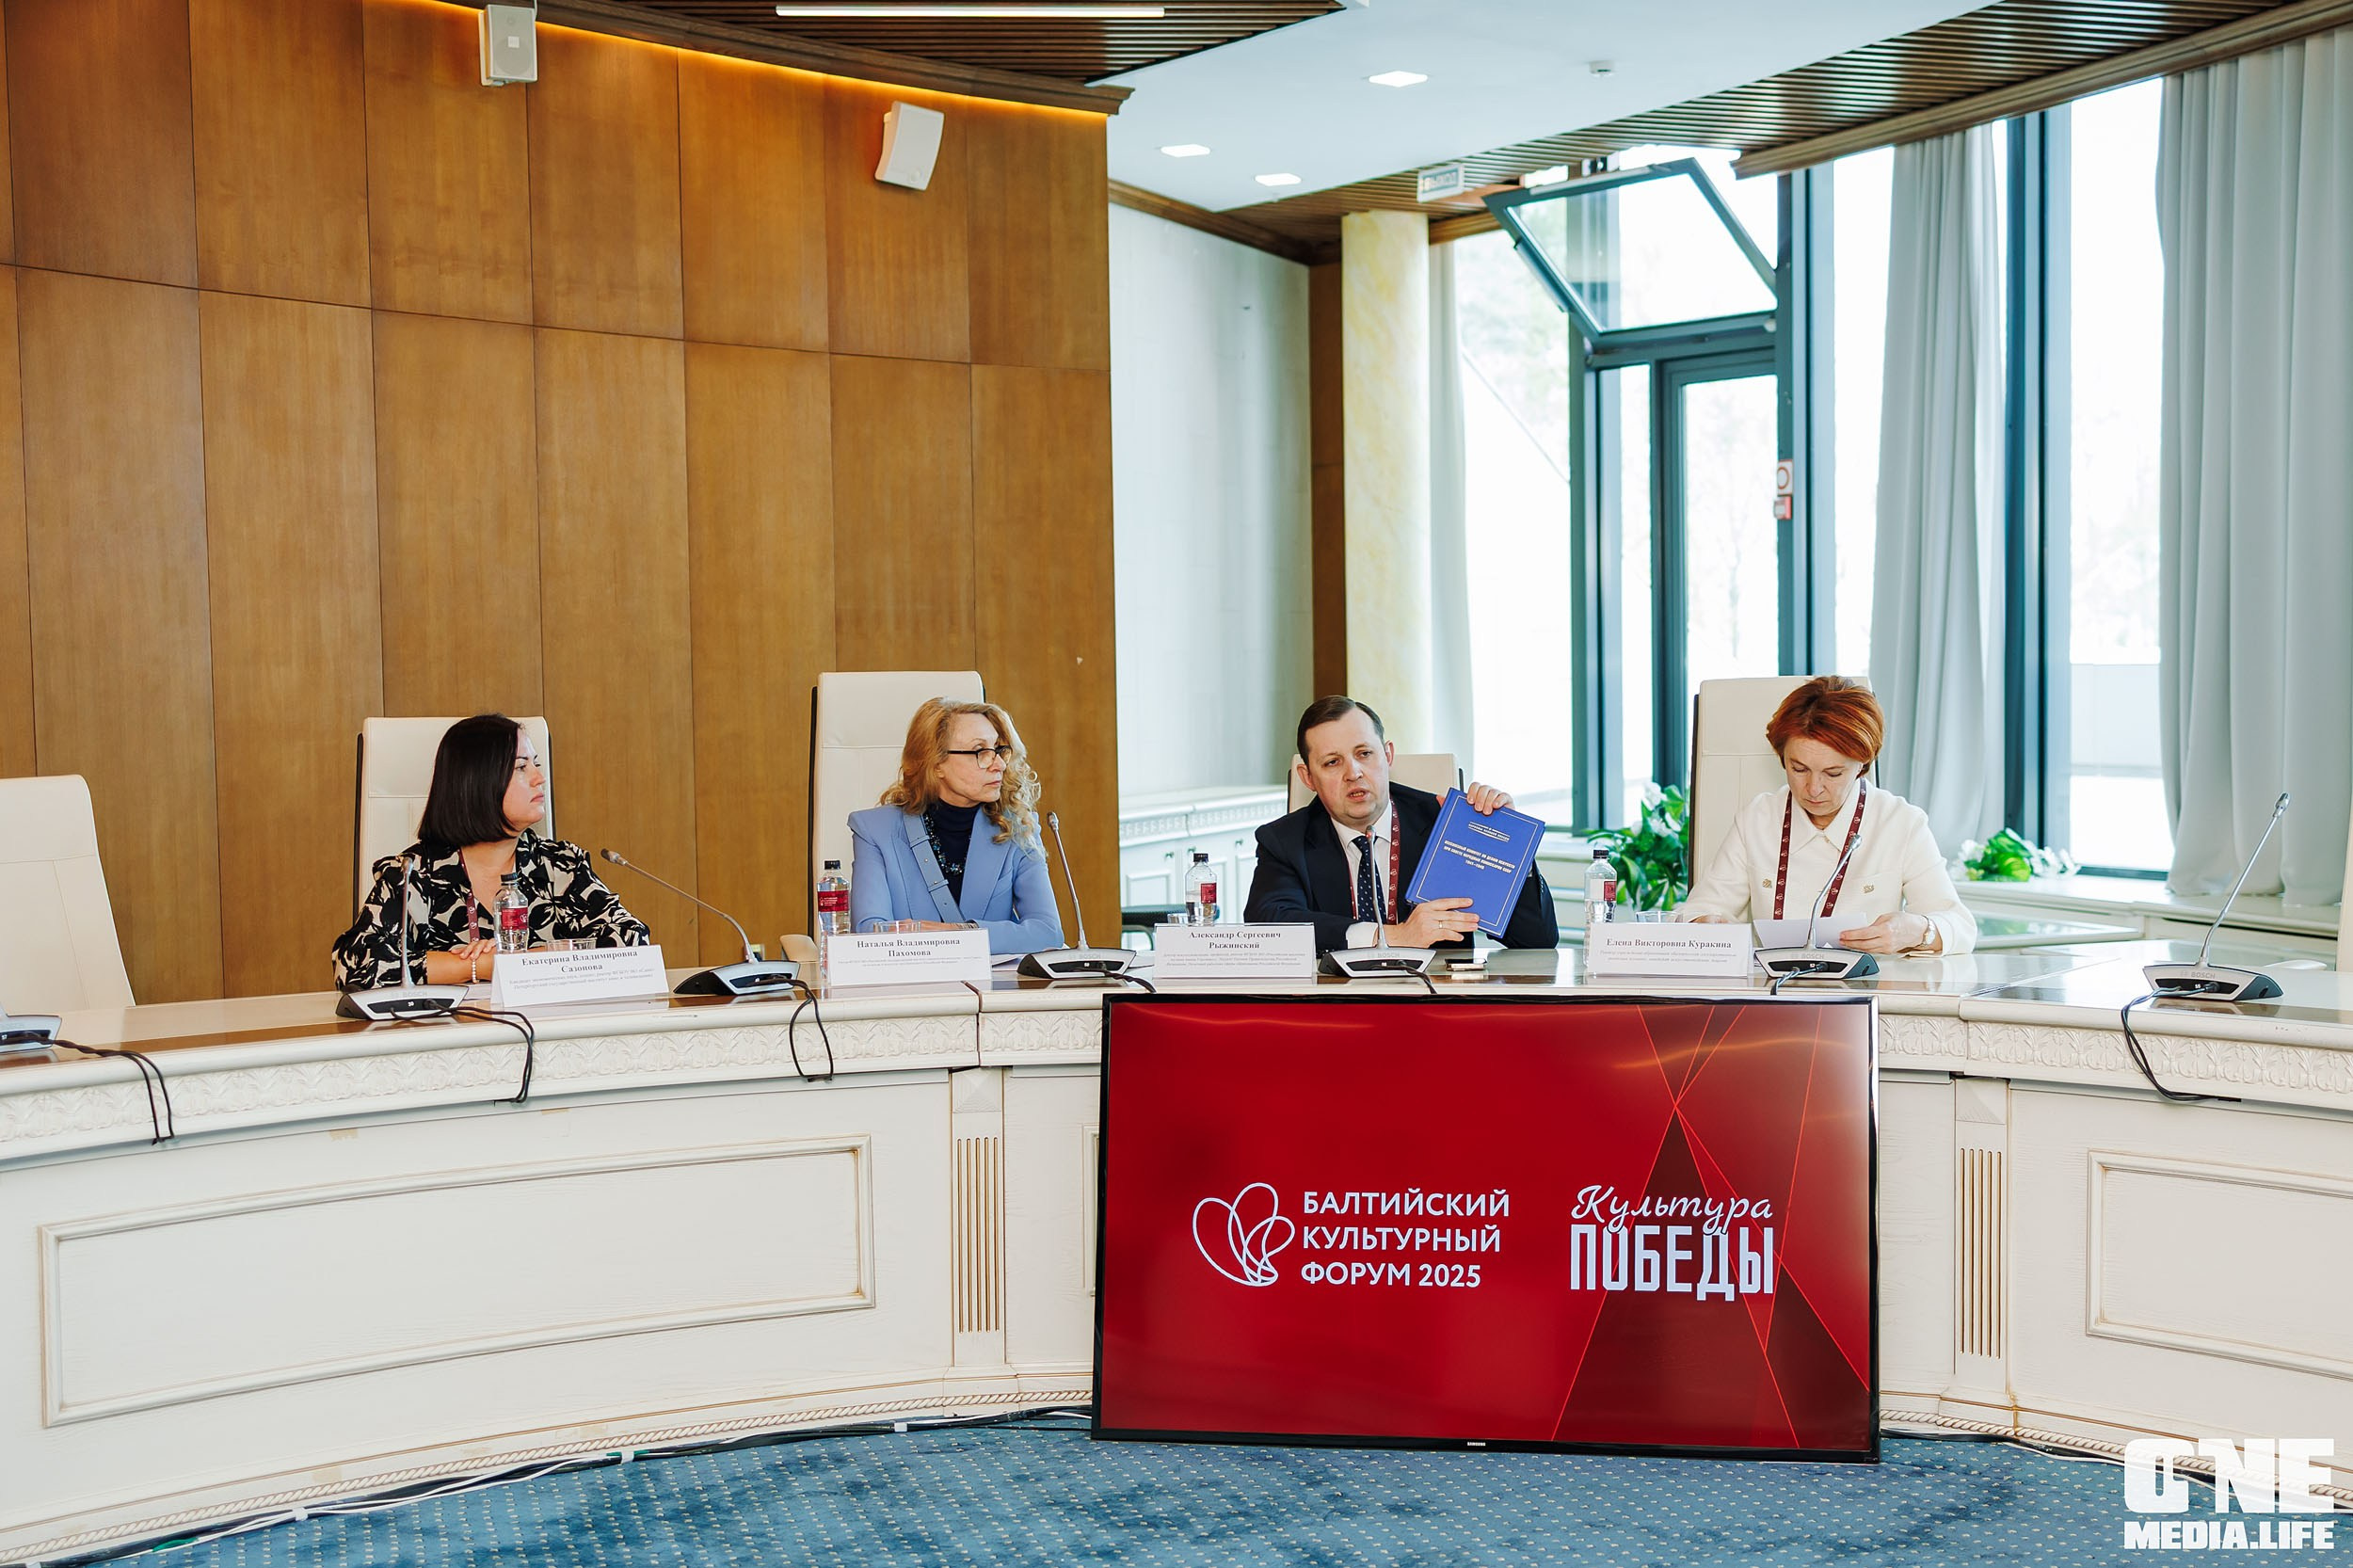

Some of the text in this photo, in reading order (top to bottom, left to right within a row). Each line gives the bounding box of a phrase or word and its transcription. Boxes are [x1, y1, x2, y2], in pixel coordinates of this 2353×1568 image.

[896, 938, 960, 947] Владимировна
[1236, 931, 1281, 939] Сергеевич
[1607, 938, 1732, 949] Елена Викторовна Куракина
[521, 951, 638, 966] Екатерина Владимировна
[561, 964, 603, 973] Сазонова
[1302, 1188, 1511, 1218] БАЛТИЙСКИЙ
[1571, 1184, 1773, 1235] Культура
[1302, 1224, 1501, 1253] КУЛЬТУРНЫЙ
[1570, 1224, 1774, 1302] ПОБЕДЫ
[1301, 1261, 1481, 1288] ФОРУМ 2025
